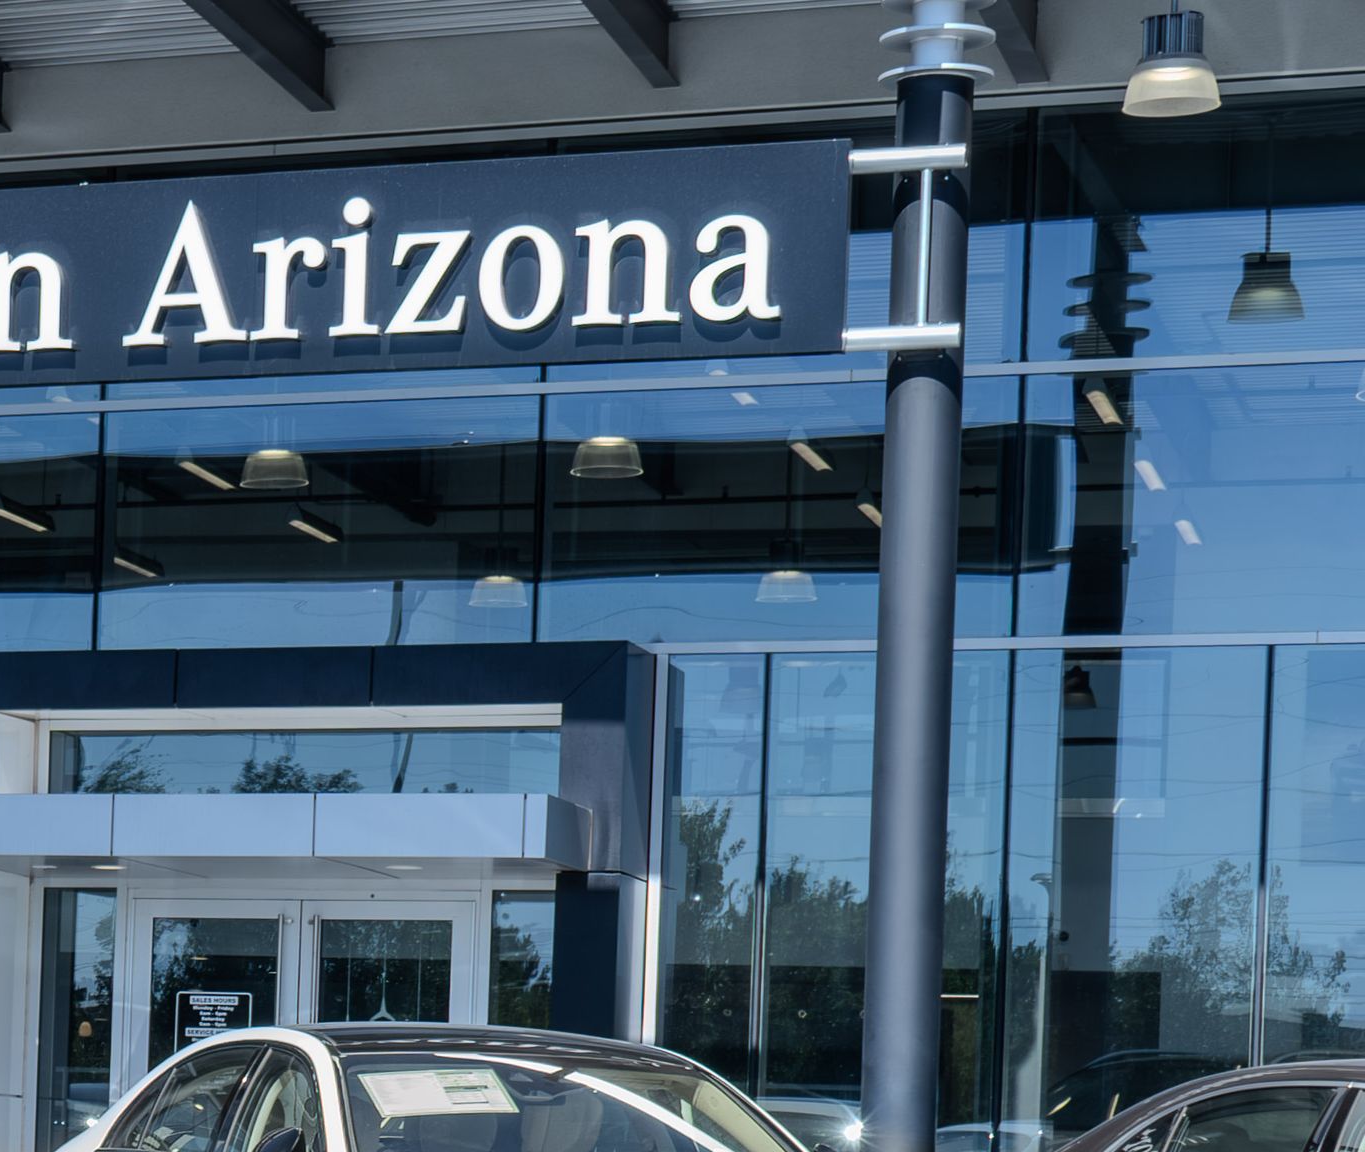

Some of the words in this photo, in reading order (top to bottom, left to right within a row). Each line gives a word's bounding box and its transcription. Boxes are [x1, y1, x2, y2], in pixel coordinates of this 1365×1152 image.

[123, 197, 780, 347] Arizona
[191, 996, 212, 1004] SALES
[213, 996, 236, 1004] HOURS
